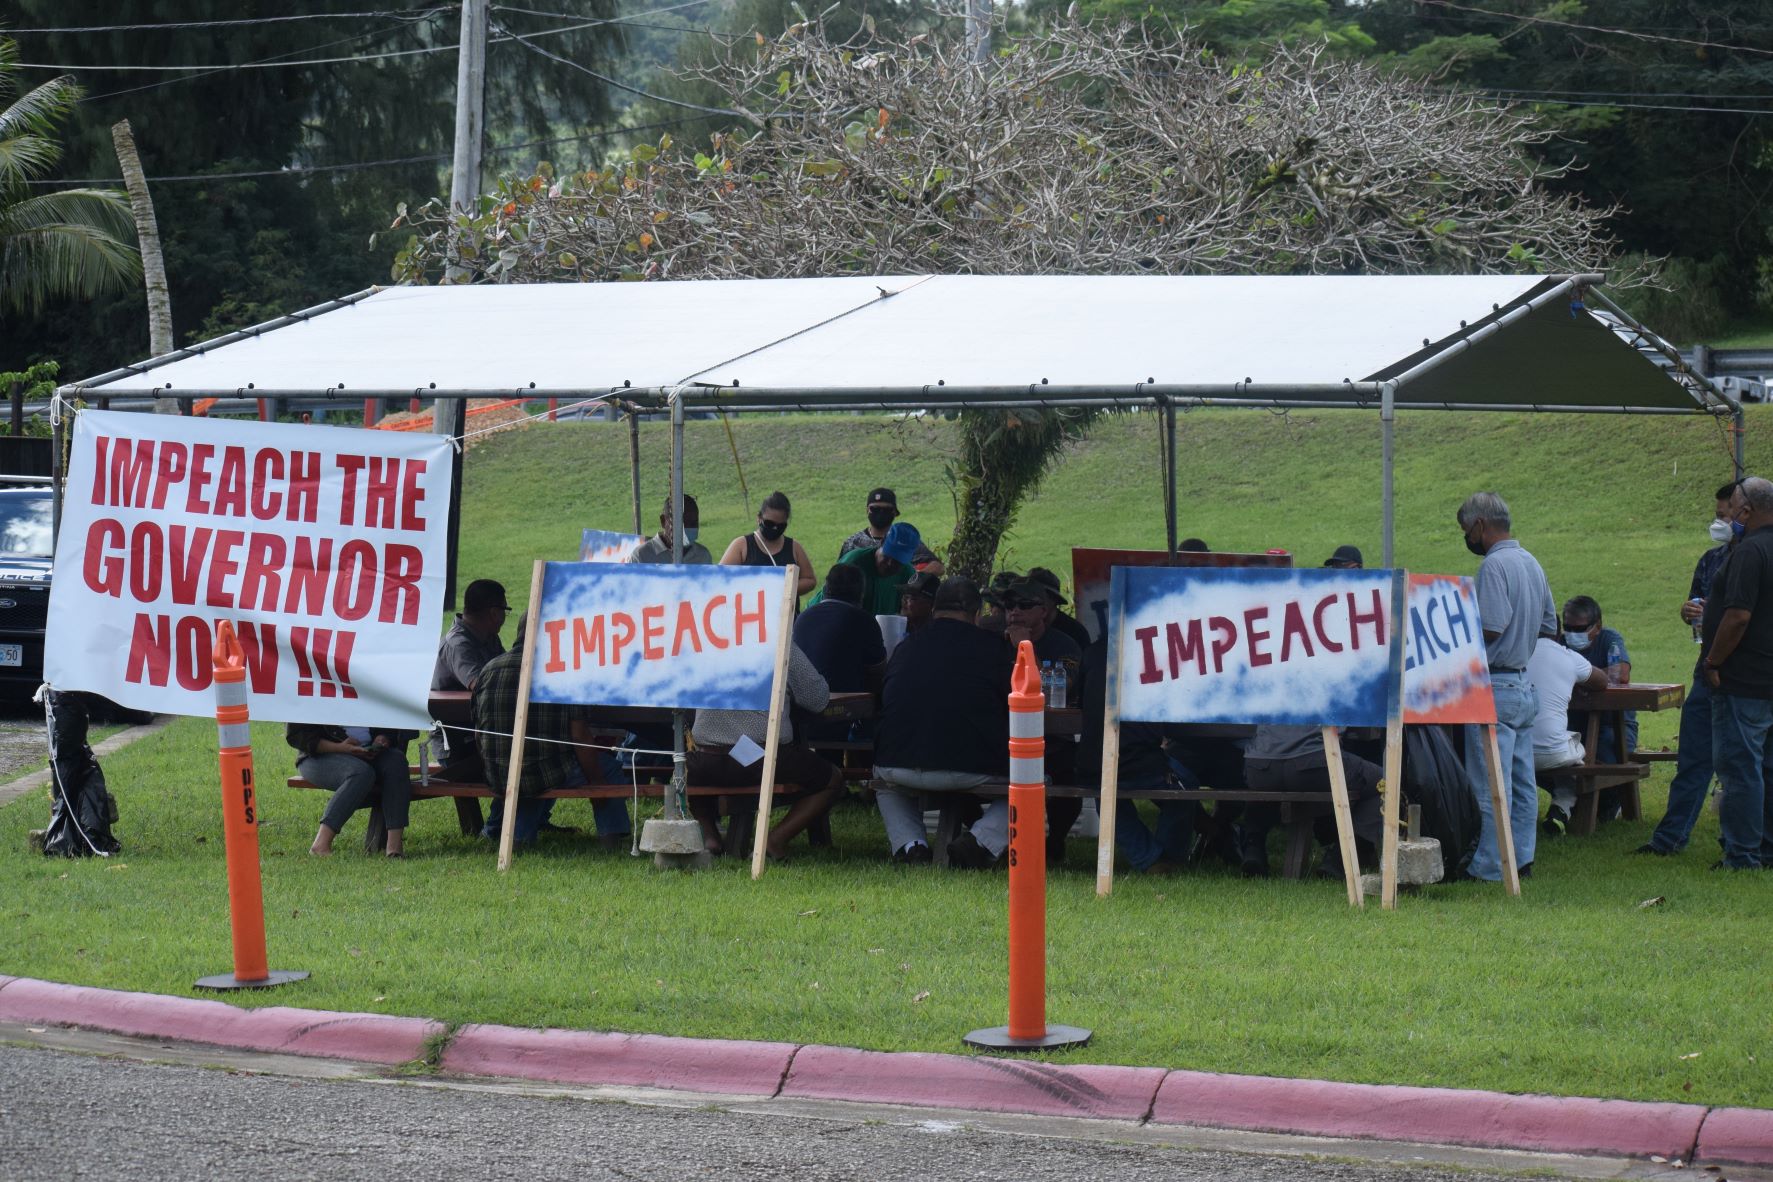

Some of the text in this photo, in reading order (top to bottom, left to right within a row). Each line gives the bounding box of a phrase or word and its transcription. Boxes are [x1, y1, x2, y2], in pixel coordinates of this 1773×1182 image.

[91, 436, 427, 531] IMPEACH THE
[0, 573, 45, 582] LICE
[83, 518, 424, 626] GOVERNOR
[125, 612, 279, 695] NOW
[544, 590, 767, 673] IMPEACH
[1135, 588, 1386, 685] IMPEACH
